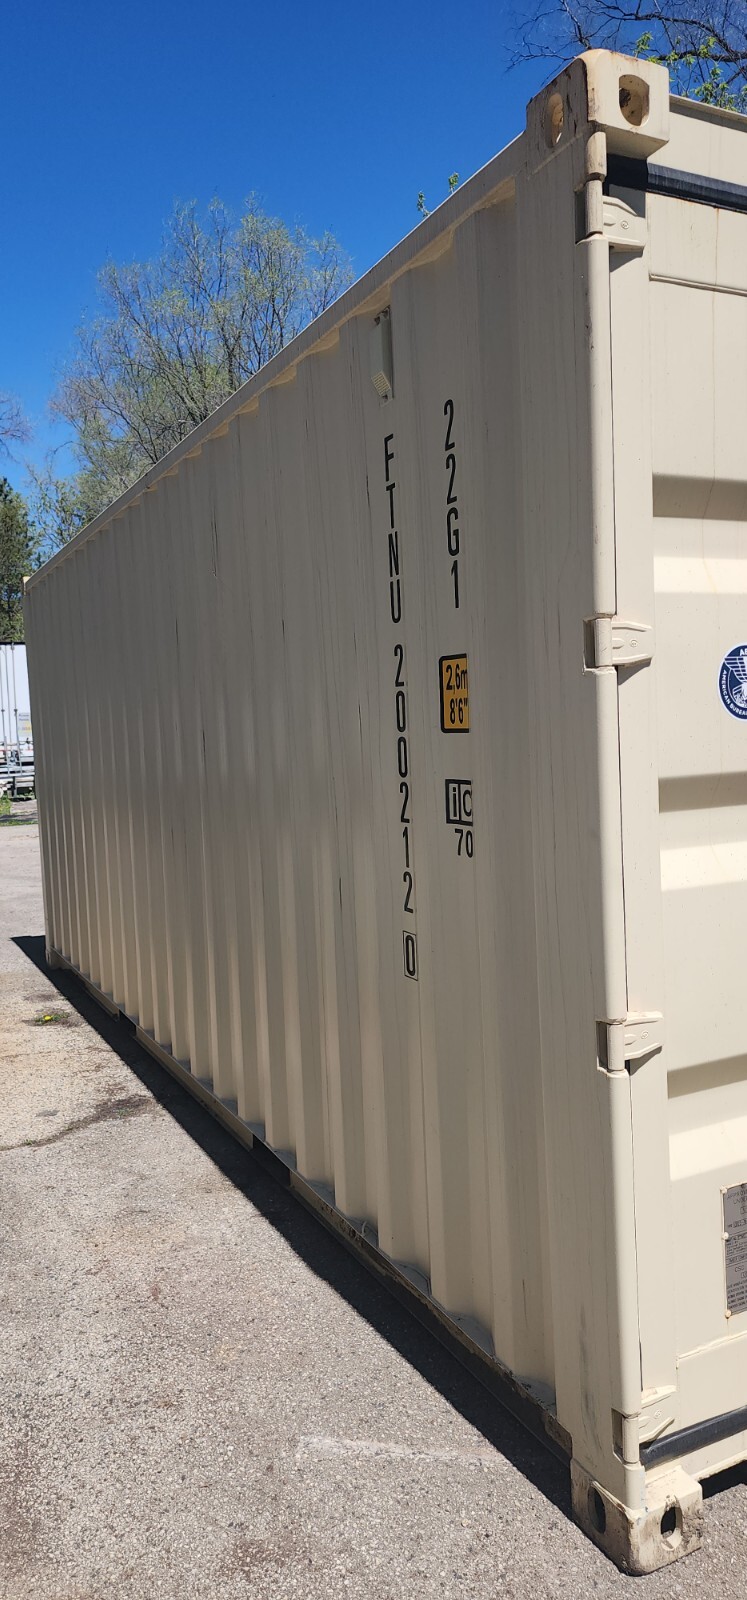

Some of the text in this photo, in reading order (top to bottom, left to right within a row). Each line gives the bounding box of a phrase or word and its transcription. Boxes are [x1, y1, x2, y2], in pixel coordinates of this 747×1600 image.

[443, 398, 459, 608] 22G1
[384, 433, 416, 977] FTNU 200212 0
[721, 669, 731, 705] AMERICAN
[454, 828, 473, 858] 70
